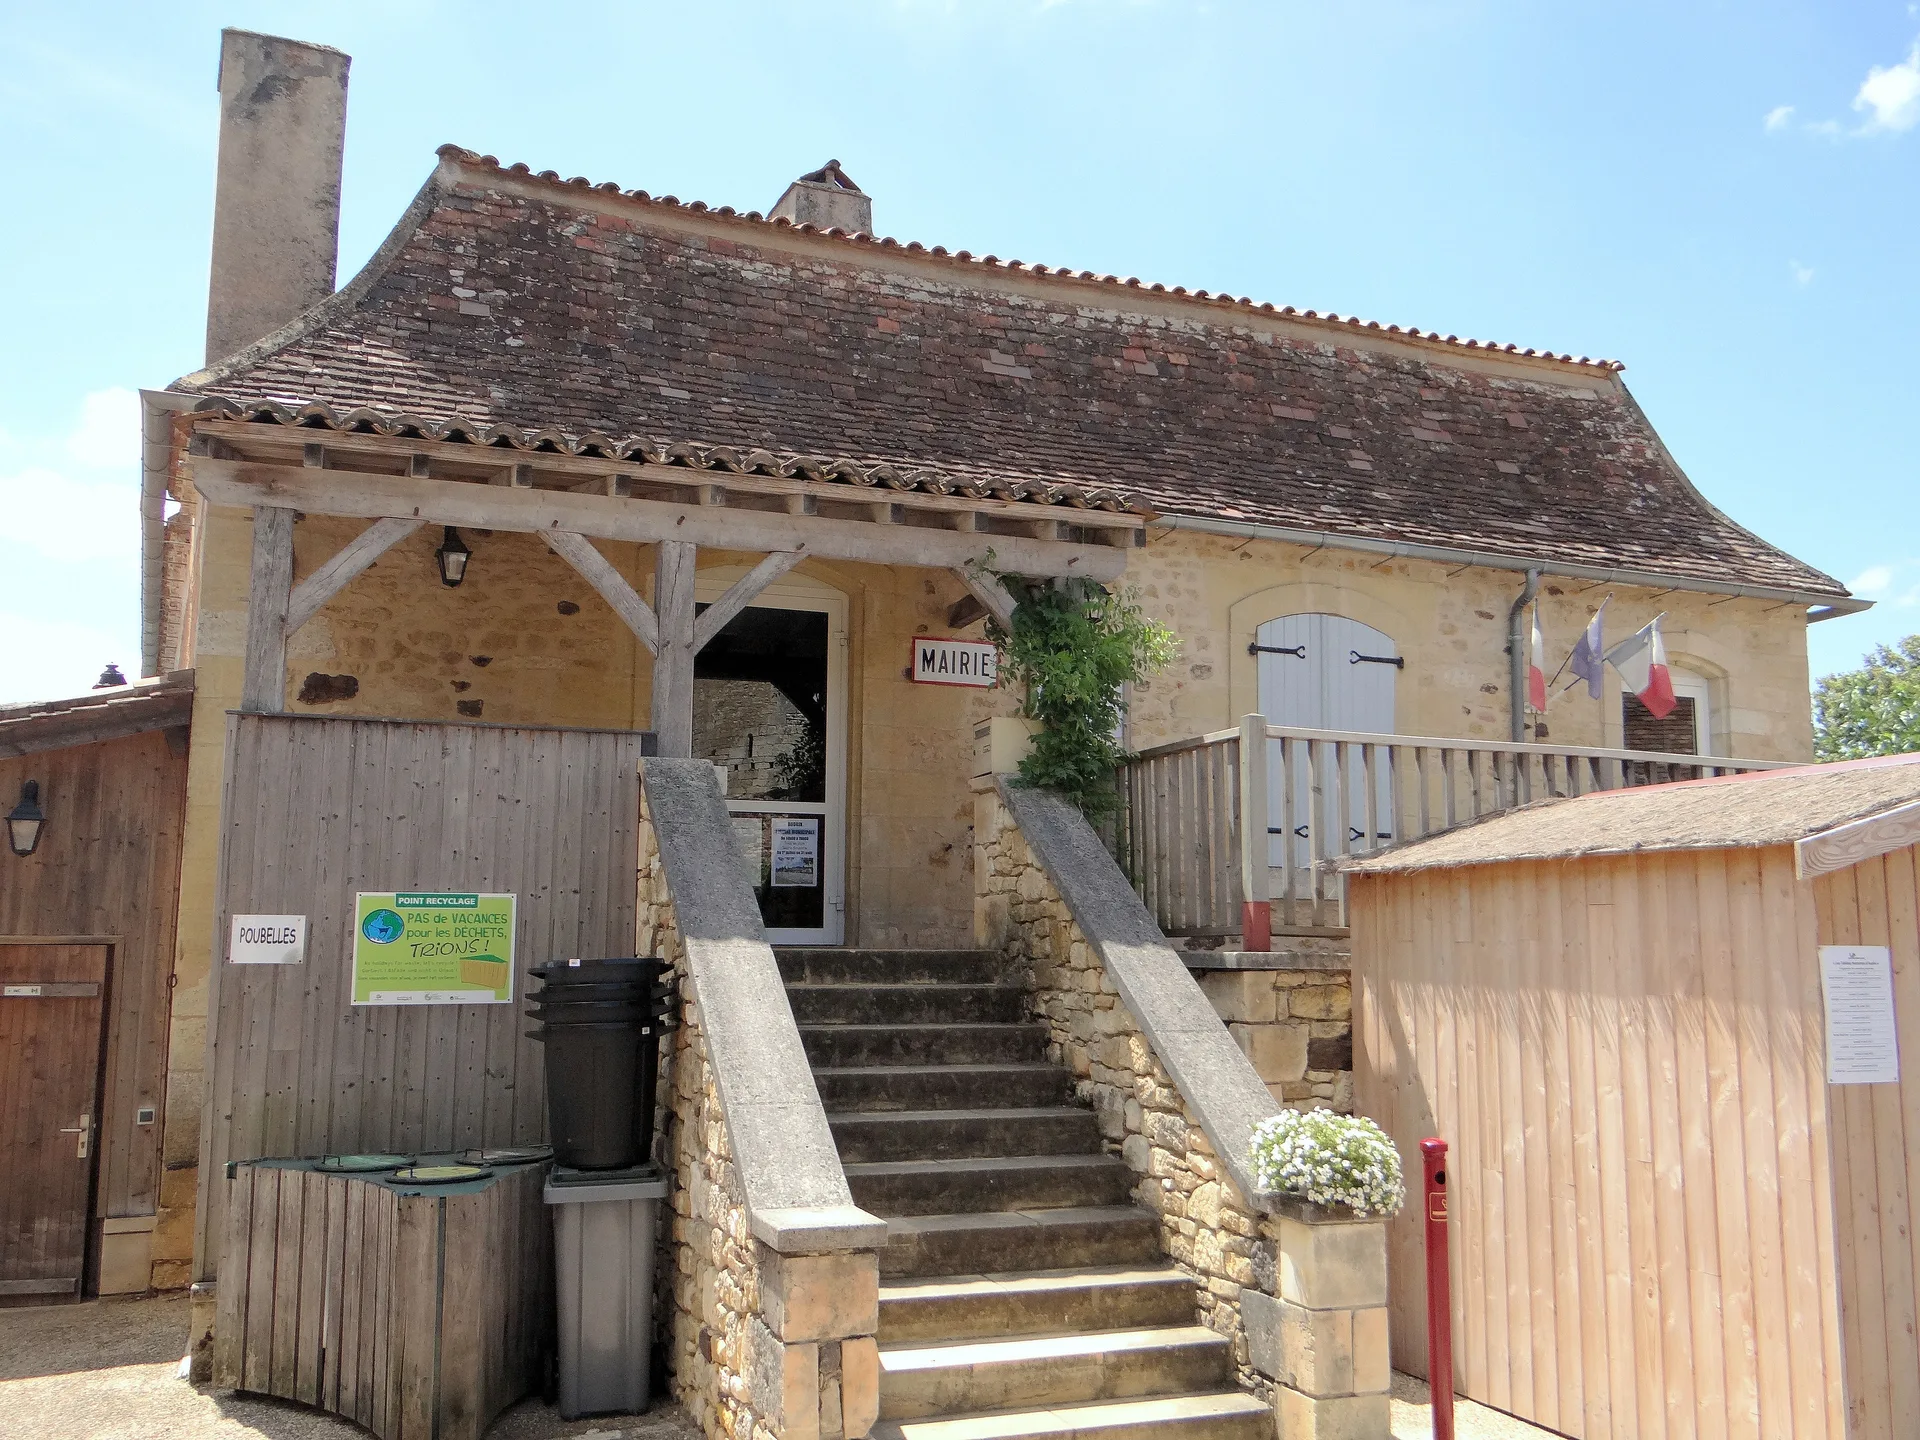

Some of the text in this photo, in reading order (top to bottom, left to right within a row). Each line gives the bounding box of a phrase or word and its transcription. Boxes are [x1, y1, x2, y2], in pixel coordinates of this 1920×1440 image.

[921, 648, 990, 677] MAIRIE
[398, 897, 476, 905] POINT RECYCLAGE
[407, 913, 508, 924] PAS de VACANCES
[239, 927, 296, 944] POUBELLES
[406, 925, 507, 940] pour les DÉCHETS,
[484, 939, 490, 952] !
